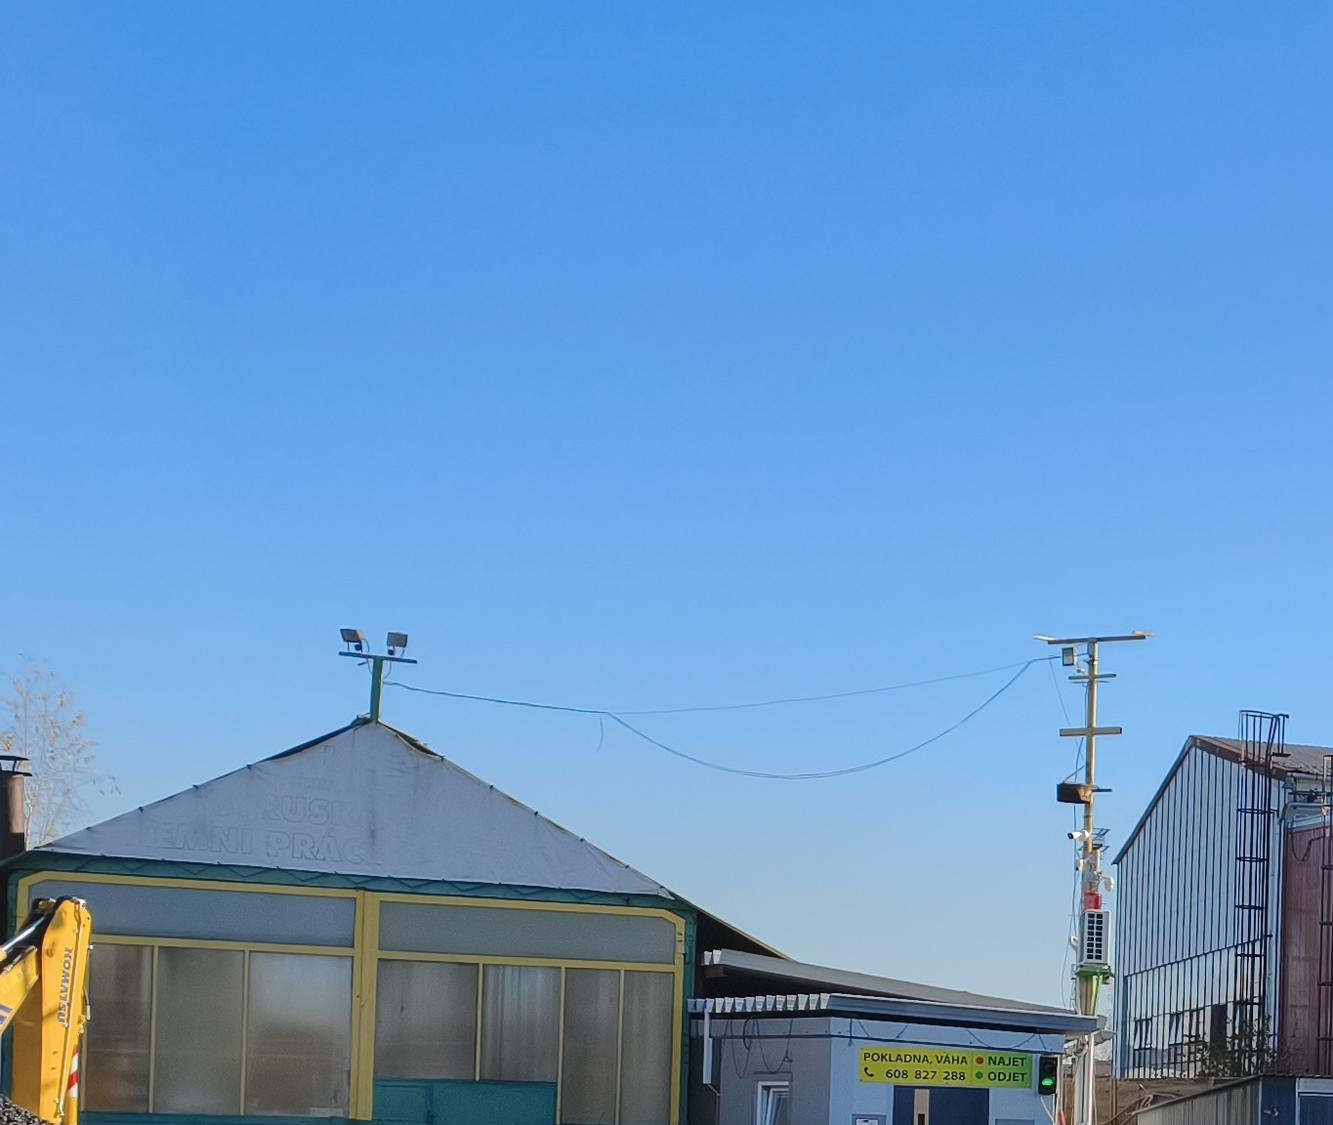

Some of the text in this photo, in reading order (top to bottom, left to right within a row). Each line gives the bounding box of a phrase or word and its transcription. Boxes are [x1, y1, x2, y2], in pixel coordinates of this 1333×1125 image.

[863, 1052, 968, 1065] POKLADNA, VÁHA
[987, 1056, 1028, 1067] NAJET
[885, 1069, 966, 1081] 608 827 288
[987, 1071, 1028, 1082] ODJET
